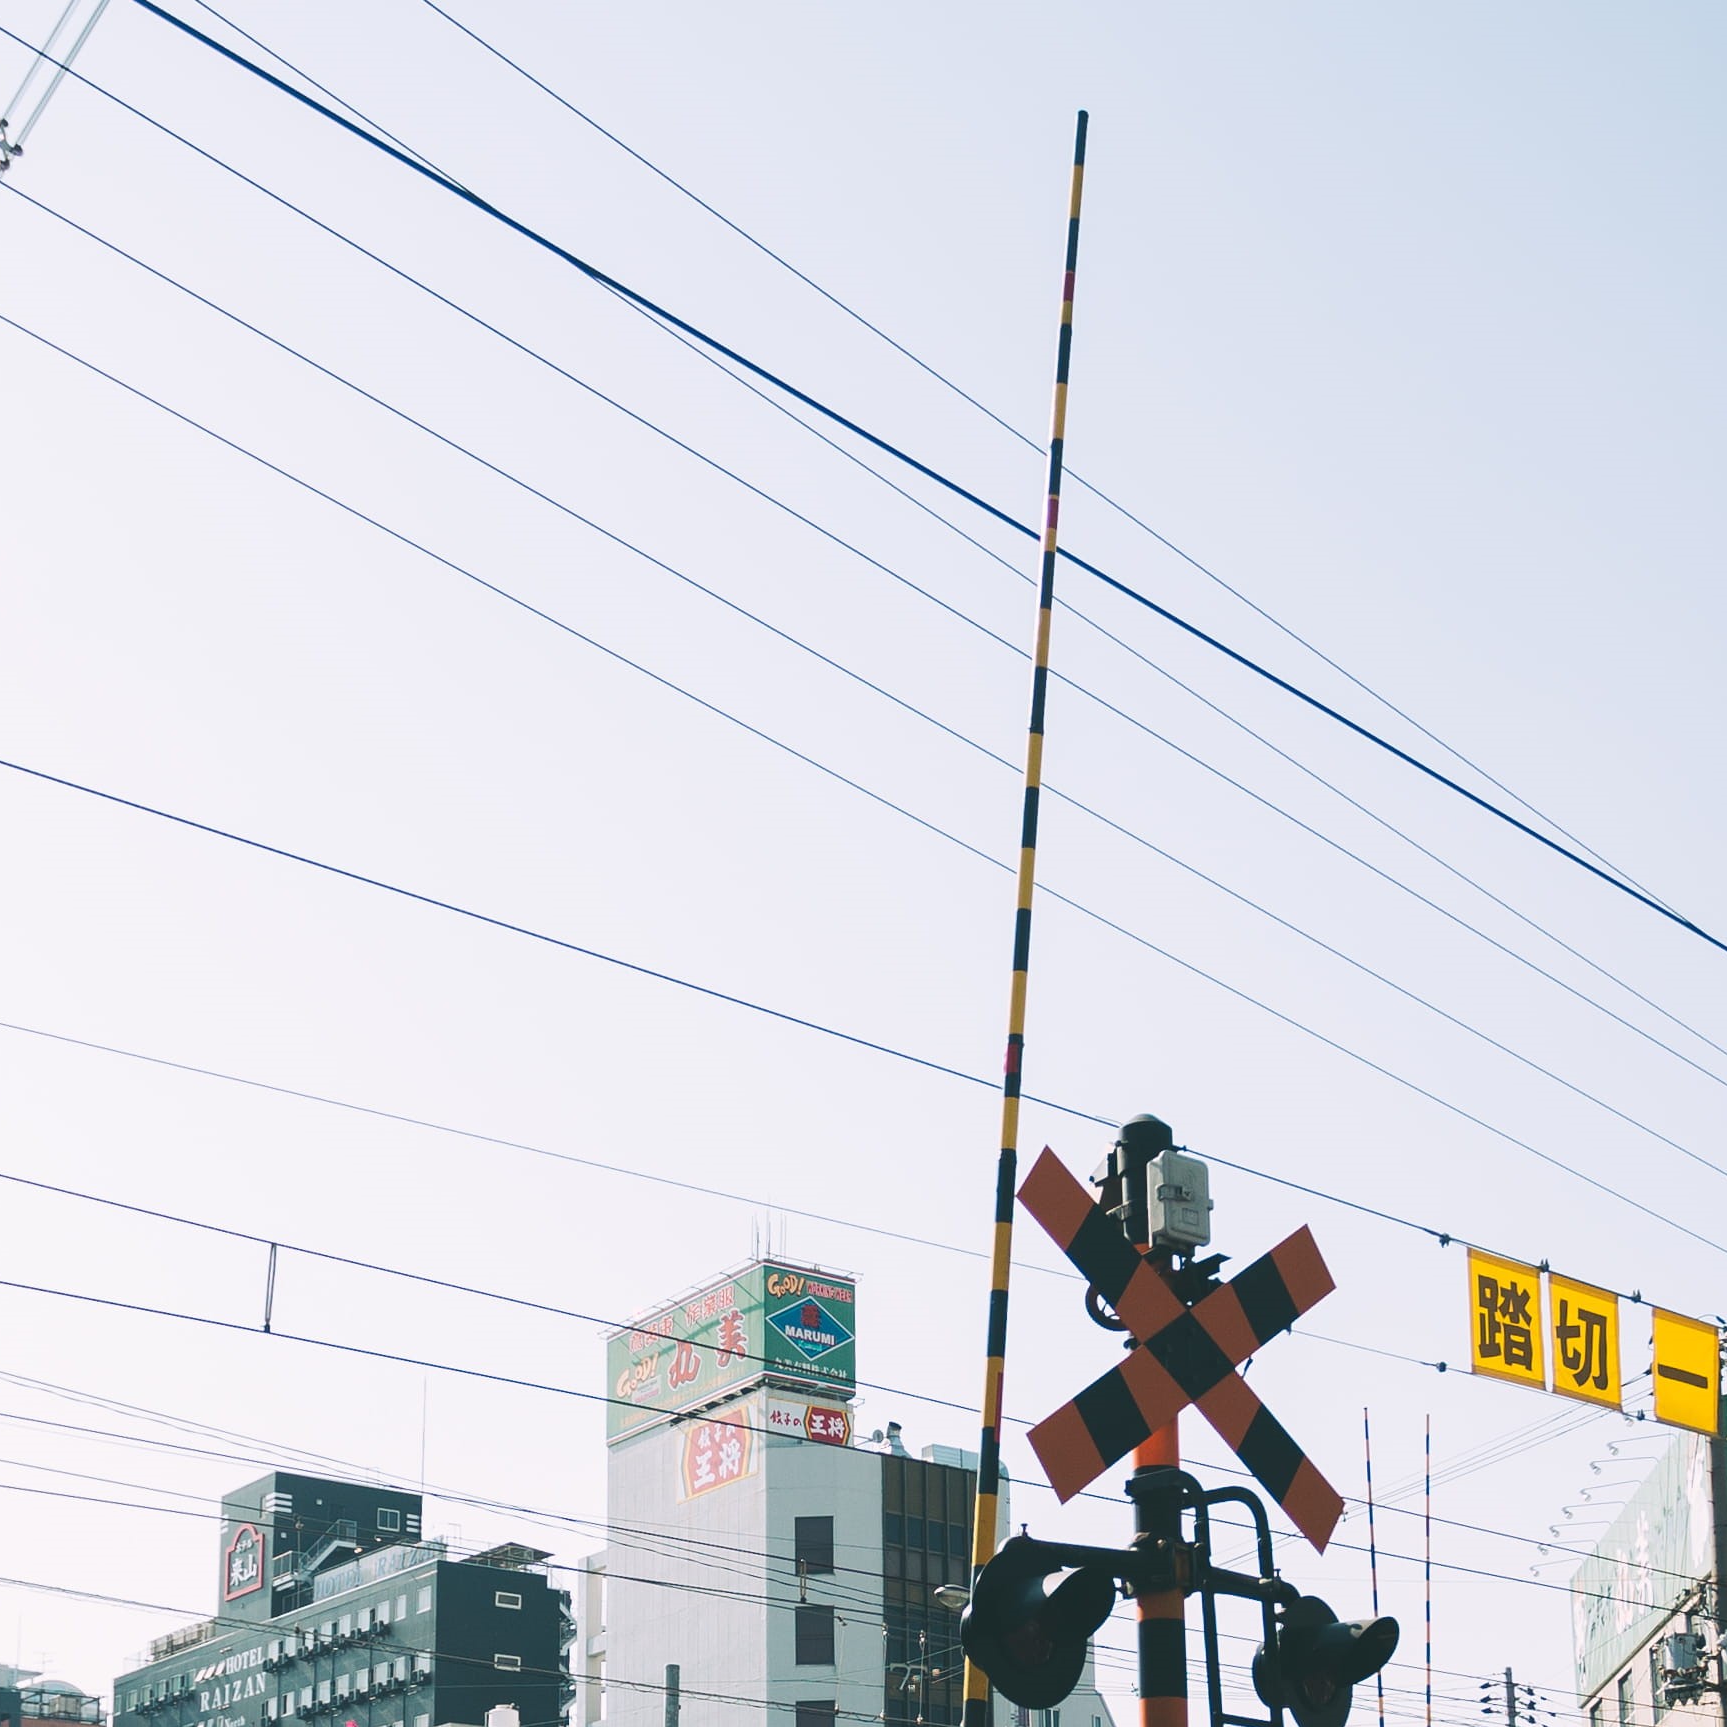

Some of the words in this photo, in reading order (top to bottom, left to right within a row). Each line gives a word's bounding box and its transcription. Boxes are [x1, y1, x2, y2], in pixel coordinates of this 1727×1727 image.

[784, 1324, 836, 1346] MARUMI
[694, 1442, 742, 1490] 王将
[314, 1562, 362, 1601] HOTEL
[226, 1646, 265, 1676] HOTEL
[200, 1671, 267, 1713] RAIZAN
